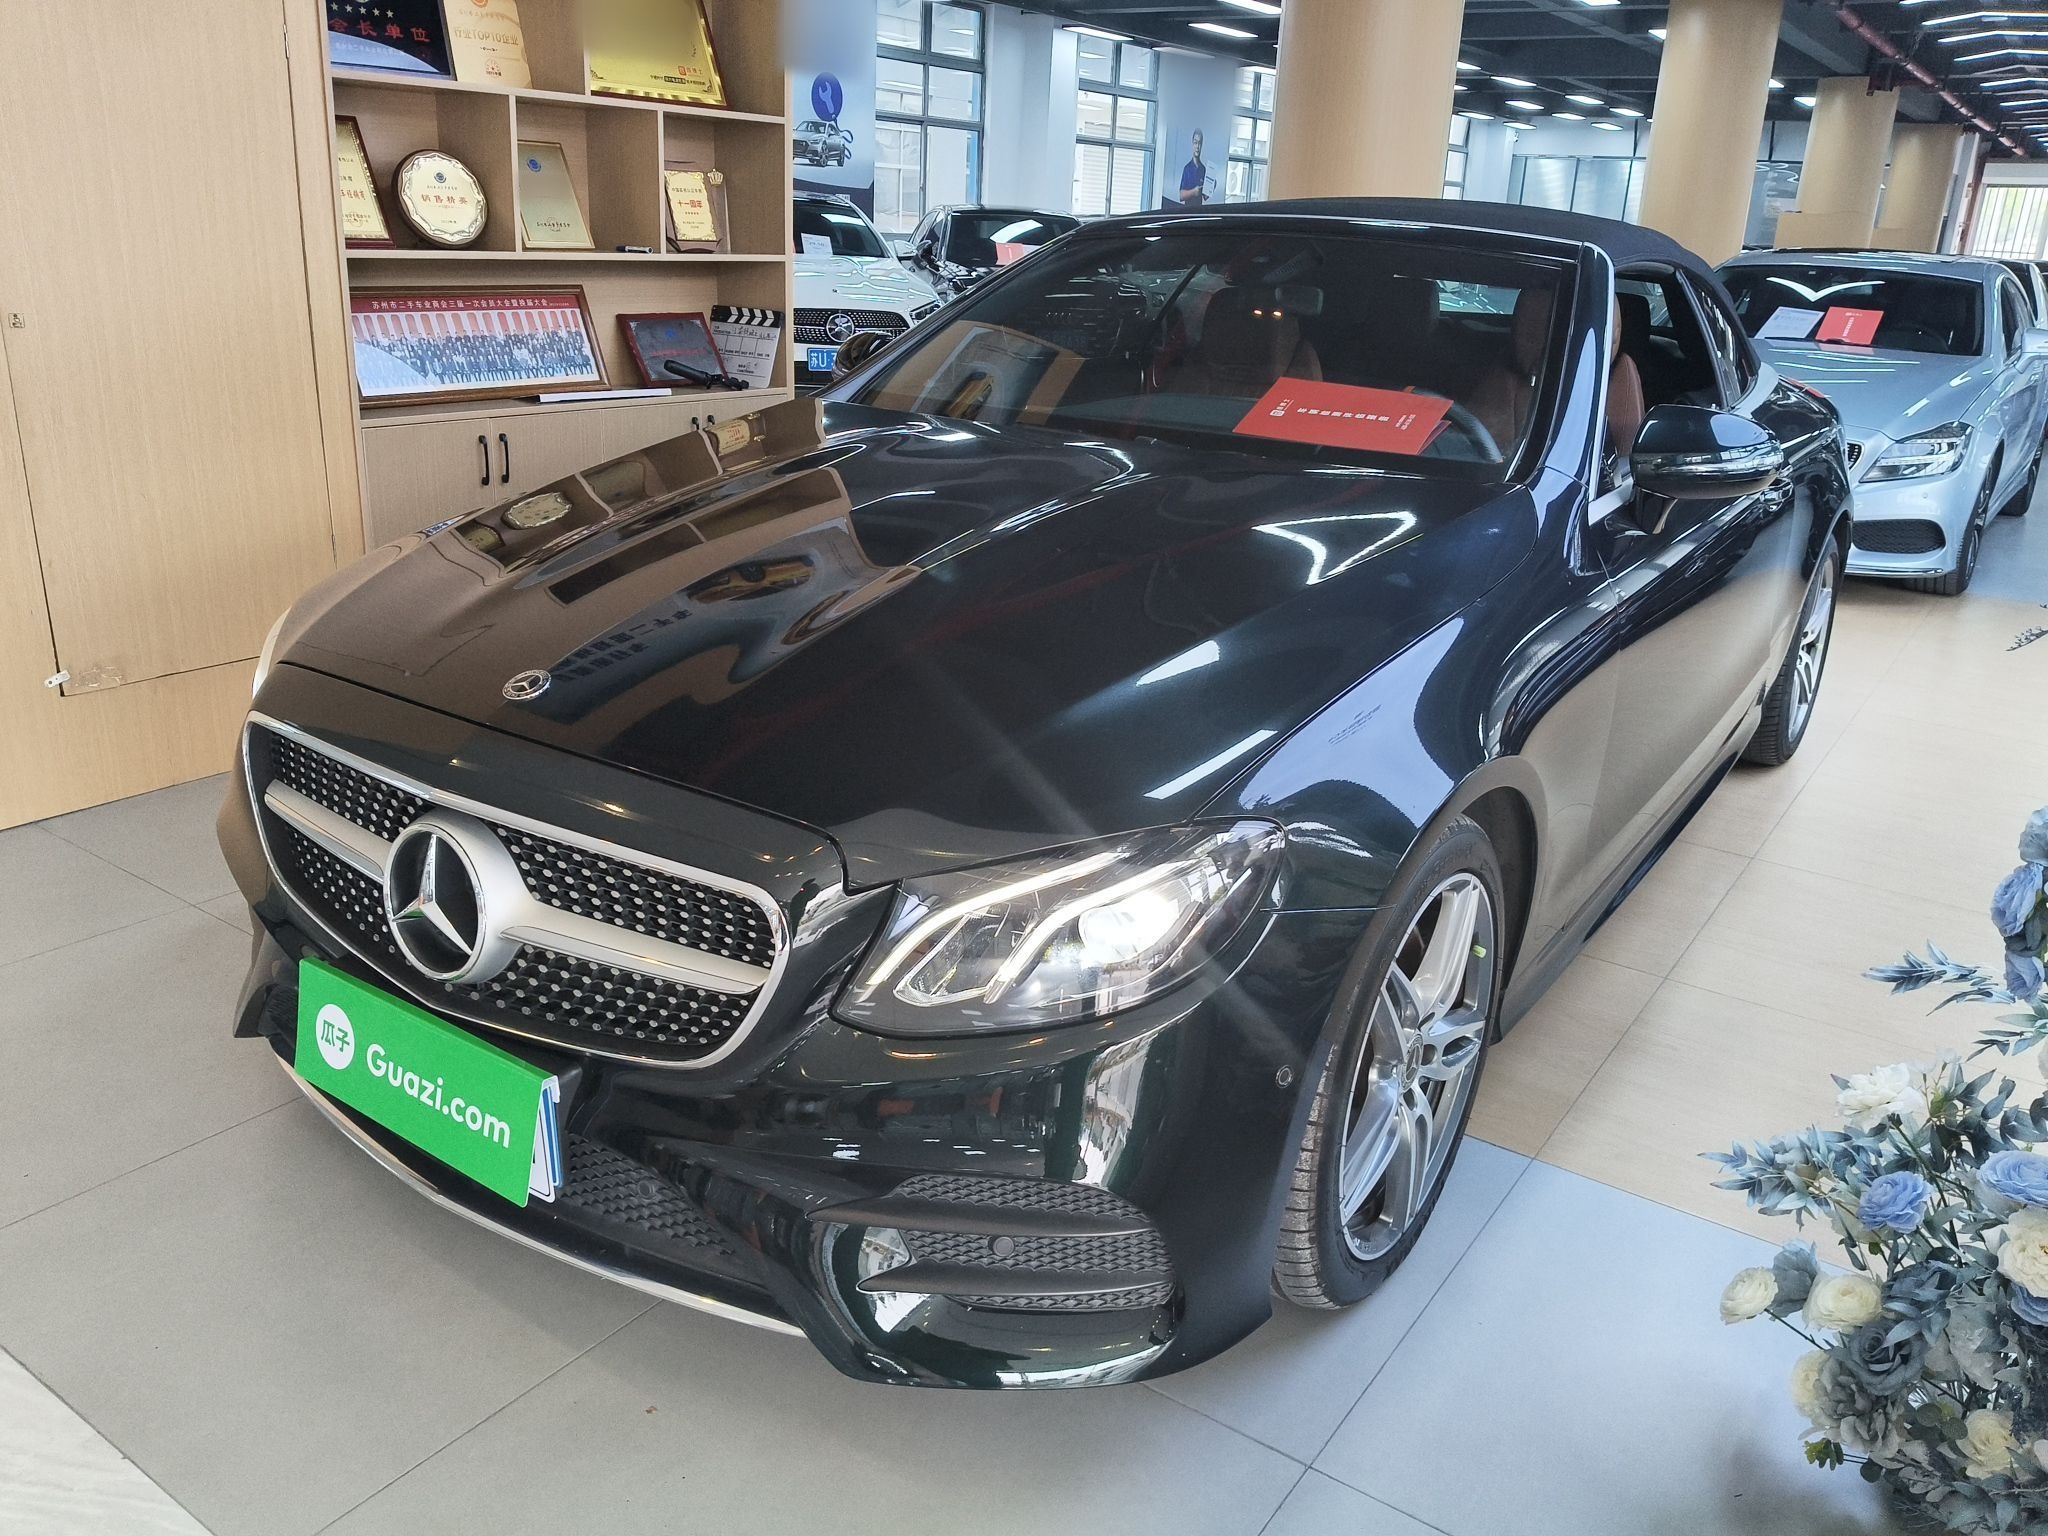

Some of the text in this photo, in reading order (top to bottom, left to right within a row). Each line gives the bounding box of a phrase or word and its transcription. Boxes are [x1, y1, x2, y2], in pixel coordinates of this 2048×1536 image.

[329, 17, 431, 43] 会长单位
[320, 1018, 351, 1053] 瓜子
[366, 1043, 512, 1149] Guazi.com
